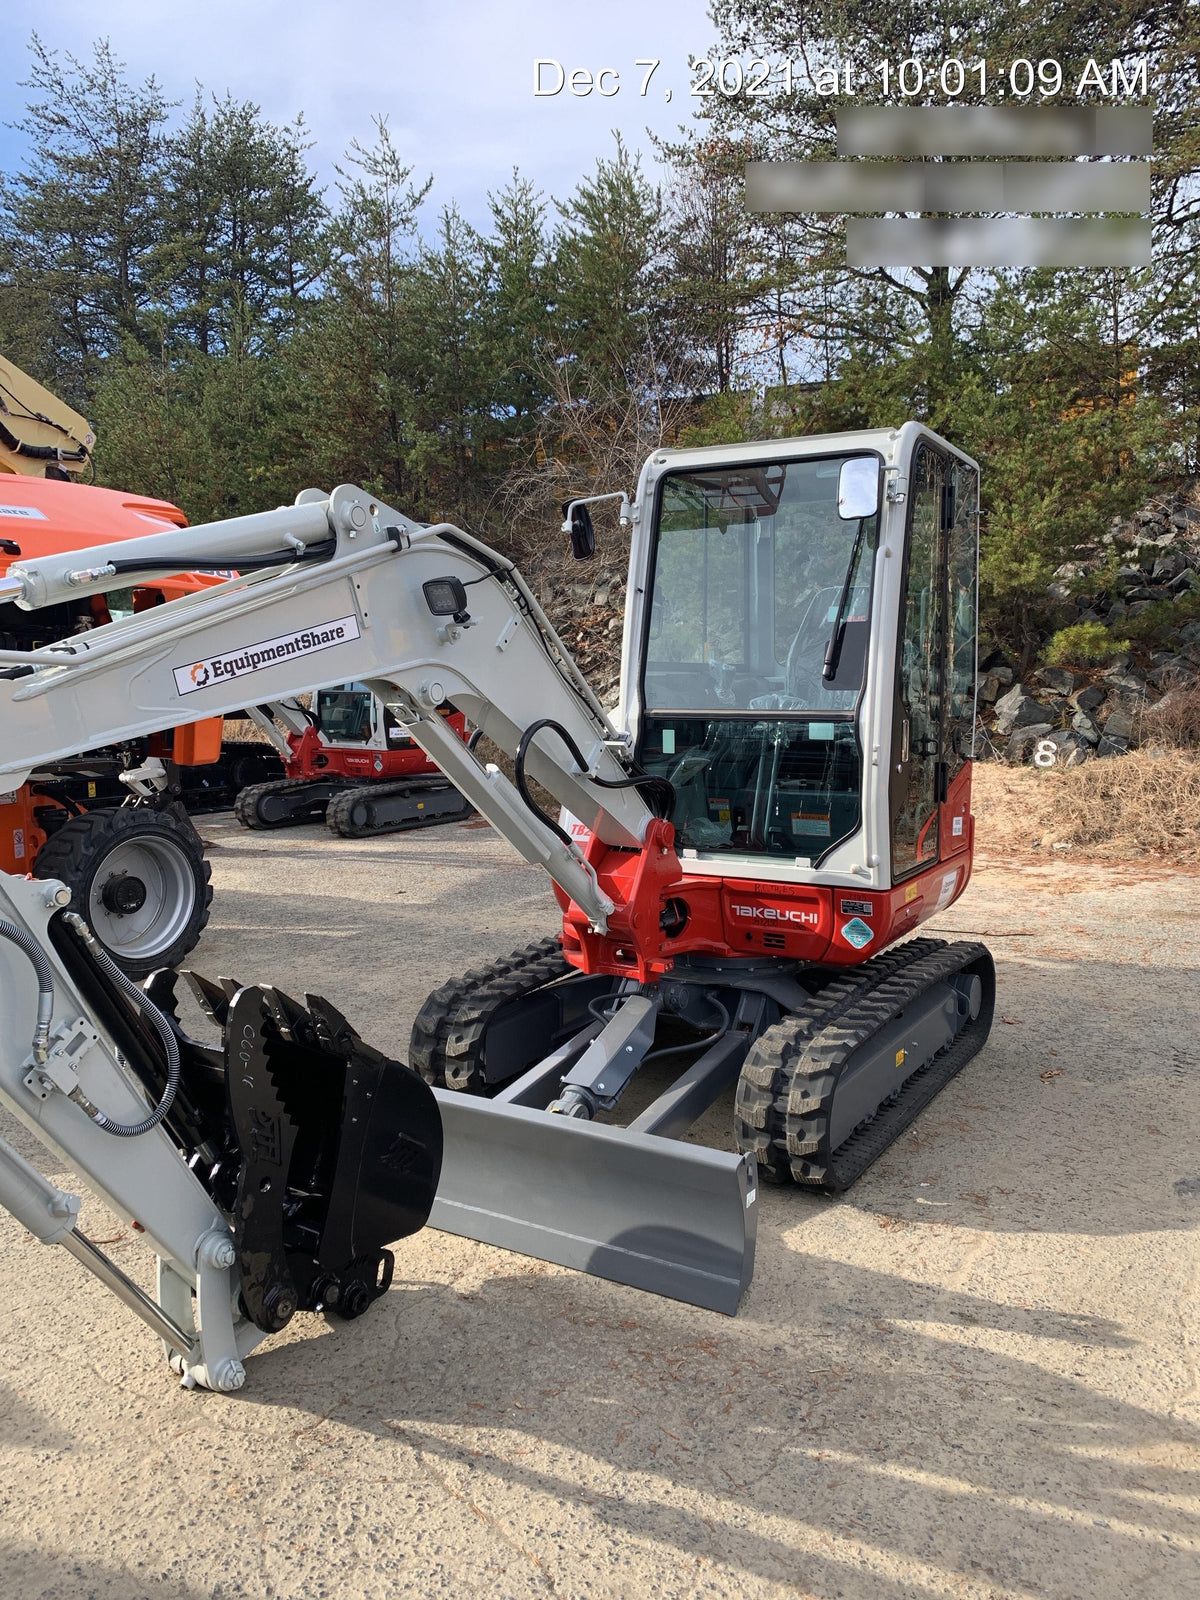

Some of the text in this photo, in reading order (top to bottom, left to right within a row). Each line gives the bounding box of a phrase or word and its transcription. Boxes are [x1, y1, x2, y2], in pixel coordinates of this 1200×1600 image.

[210, 626, 345, 677] EquipmentShare
[1034, 740, 1057, 767] 8
[731, 904, 818, 924] TAKEUCHI
